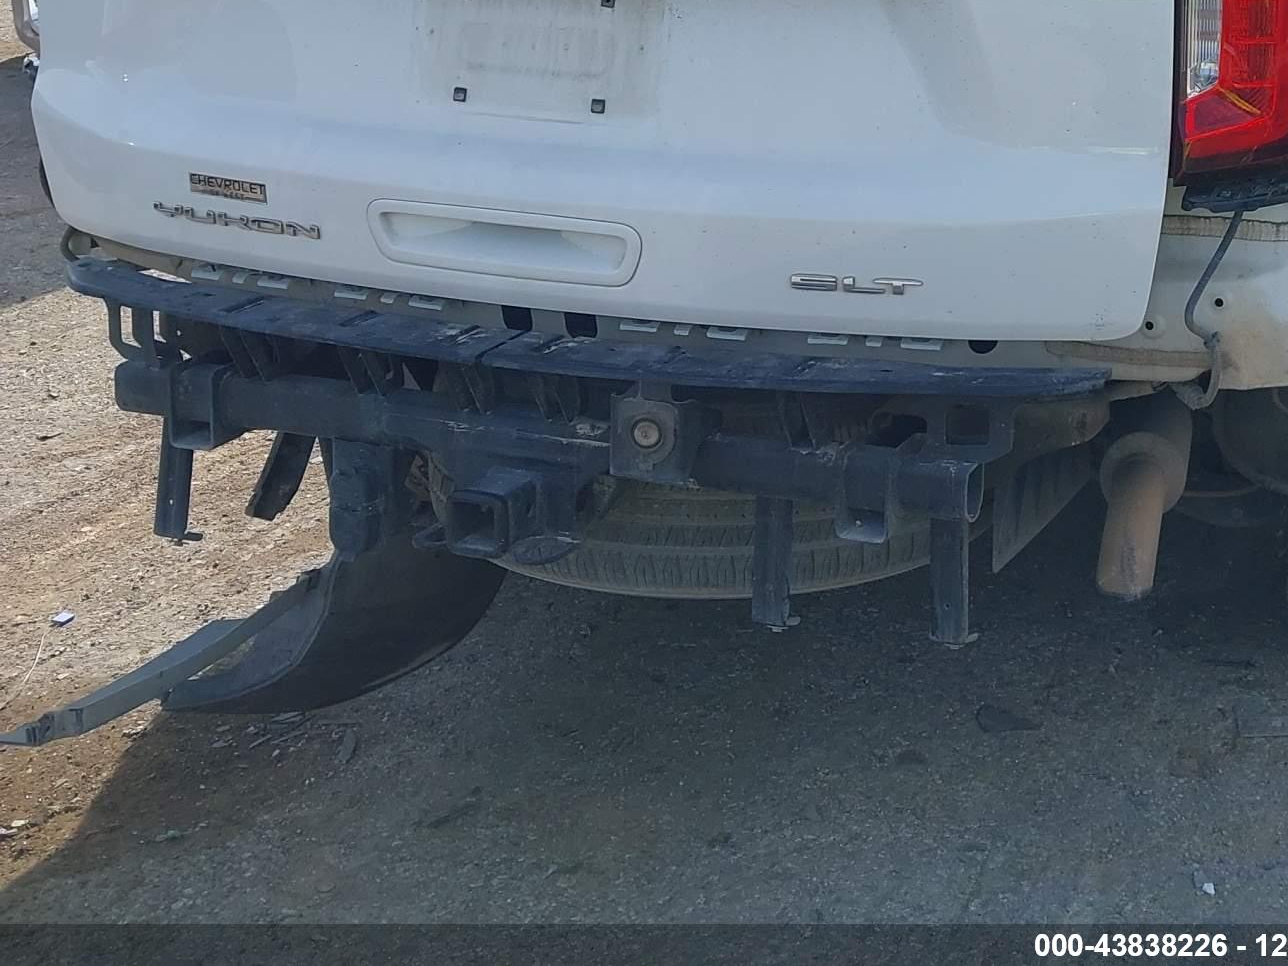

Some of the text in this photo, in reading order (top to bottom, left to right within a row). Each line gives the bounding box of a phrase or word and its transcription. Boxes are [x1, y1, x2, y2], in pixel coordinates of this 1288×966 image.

[191, 173, 265, 196] CHEVROLET
[153, 200, 321, 240] YUKON
[790, 273, 924, 296] SLT
